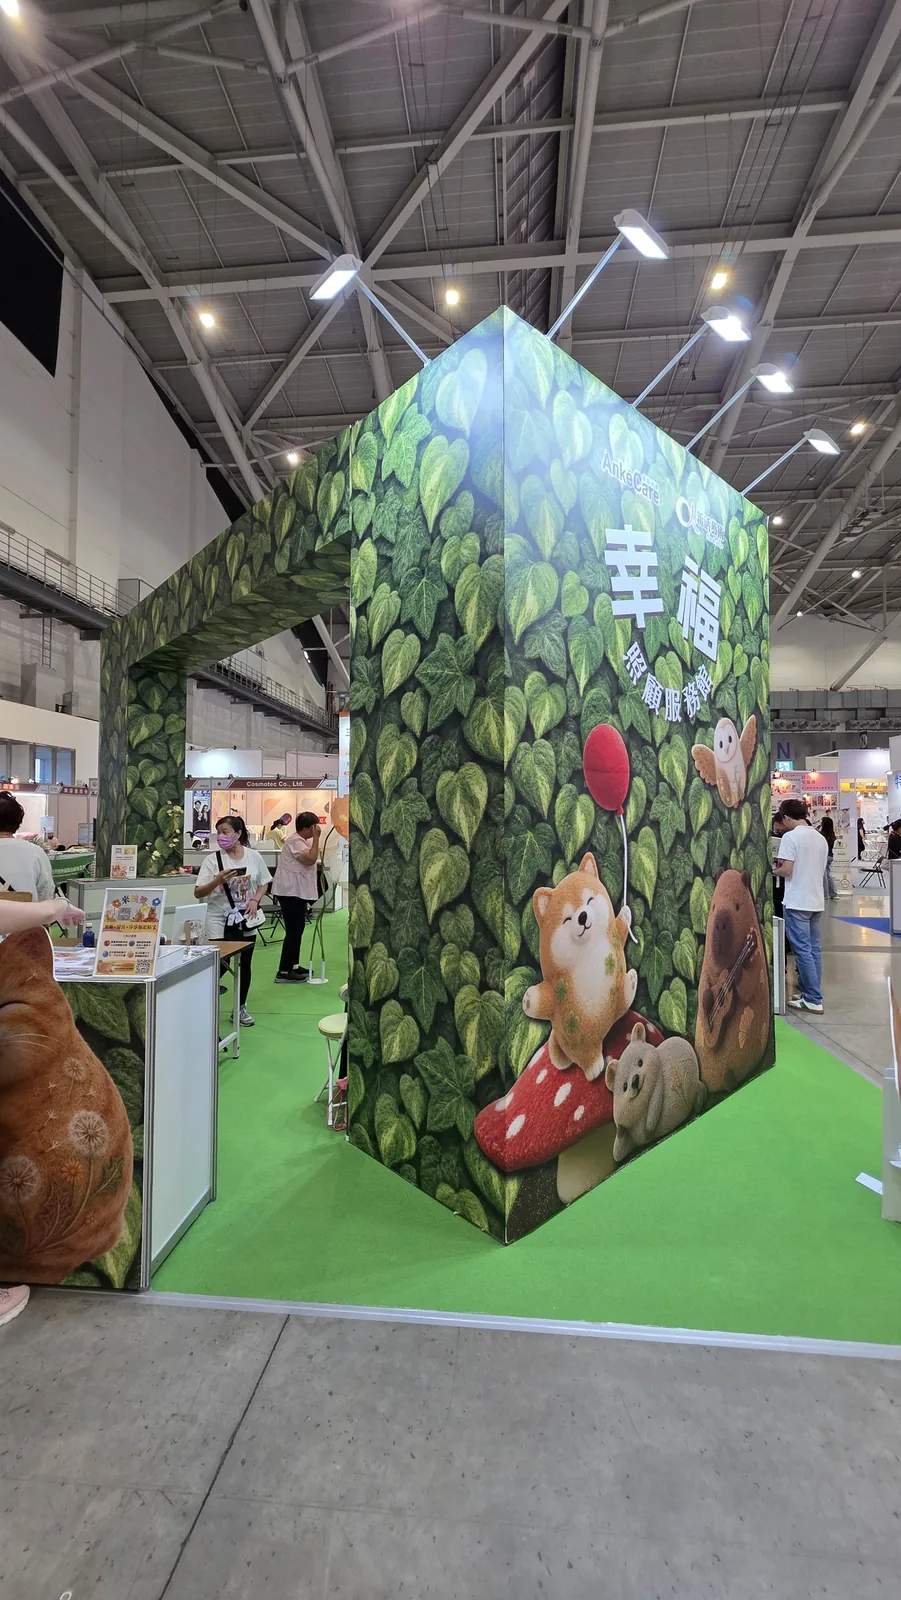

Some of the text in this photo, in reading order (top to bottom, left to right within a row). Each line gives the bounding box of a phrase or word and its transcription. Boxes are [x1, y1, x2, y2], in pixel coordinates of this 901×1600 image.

[622, 641, 714, 723] 照顧服務館
[776, 742, 790, 759] N
